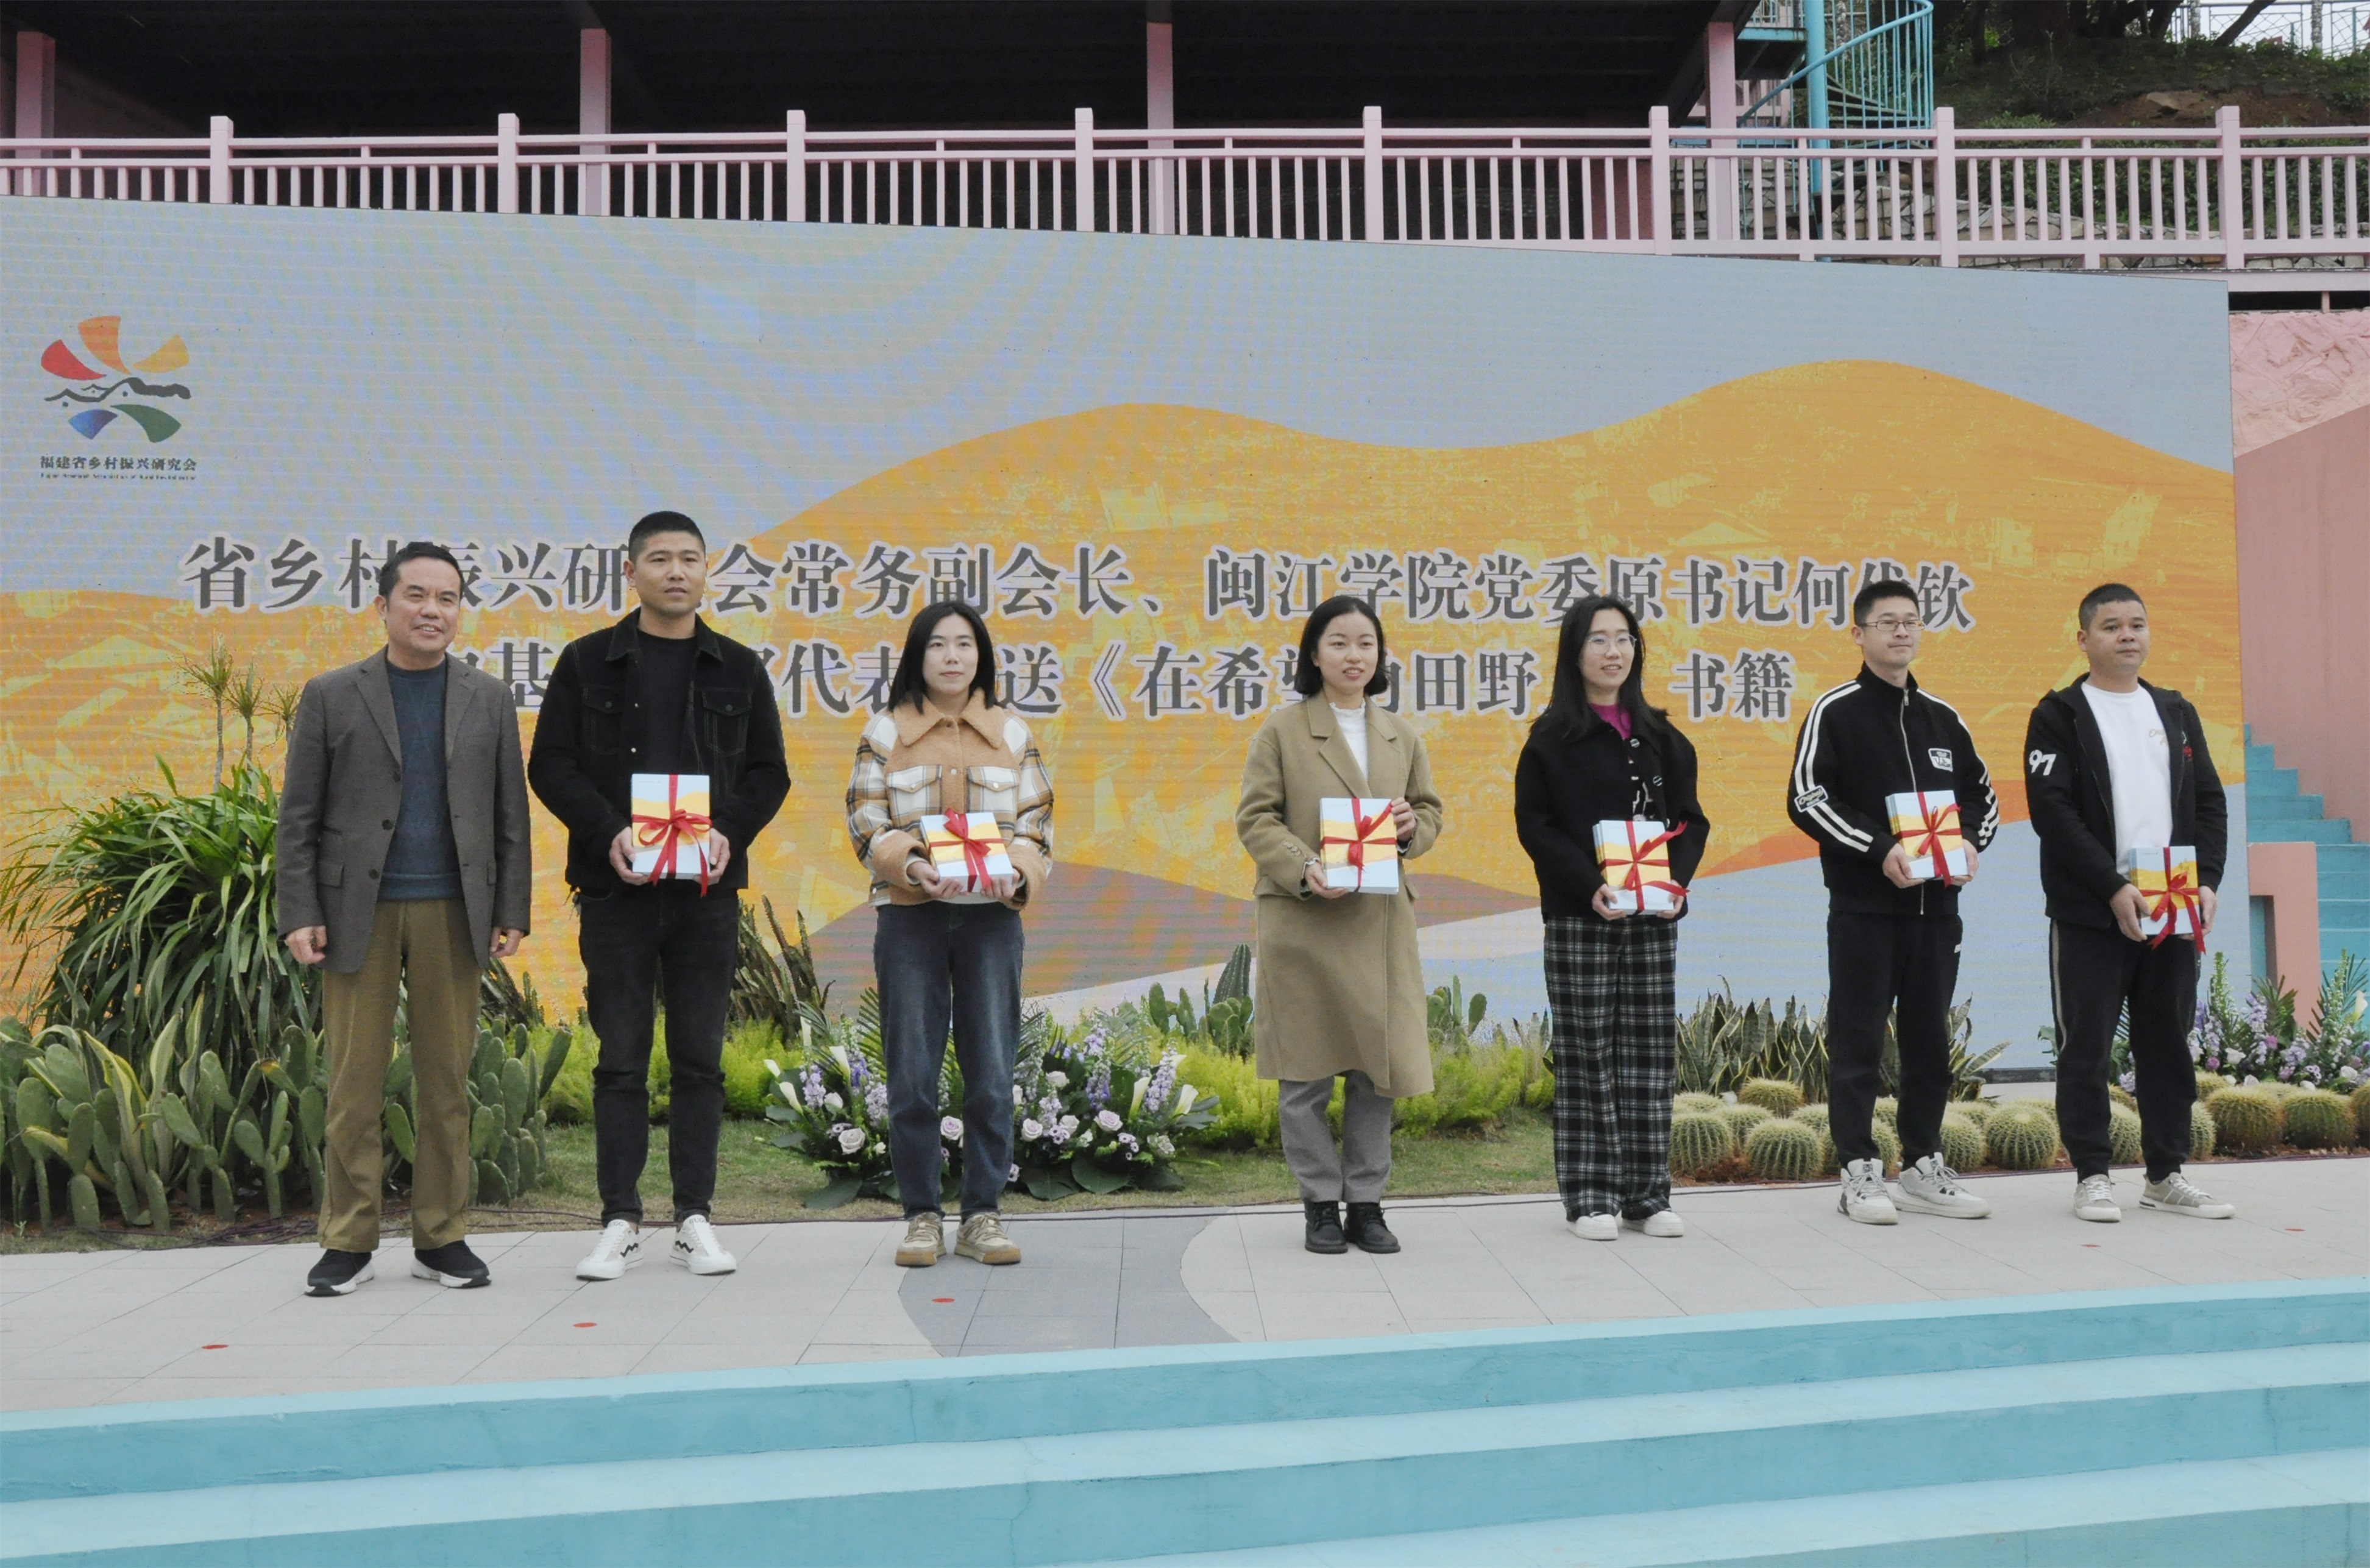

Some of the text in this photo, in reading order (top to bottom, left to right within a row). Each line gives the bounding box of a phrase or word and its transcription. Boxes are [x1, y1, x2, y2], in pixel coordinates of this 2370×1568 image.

[40, 456, 197, 471] 福建省乡村振兴研究会
[2029, 750, 2056, 776] 97
